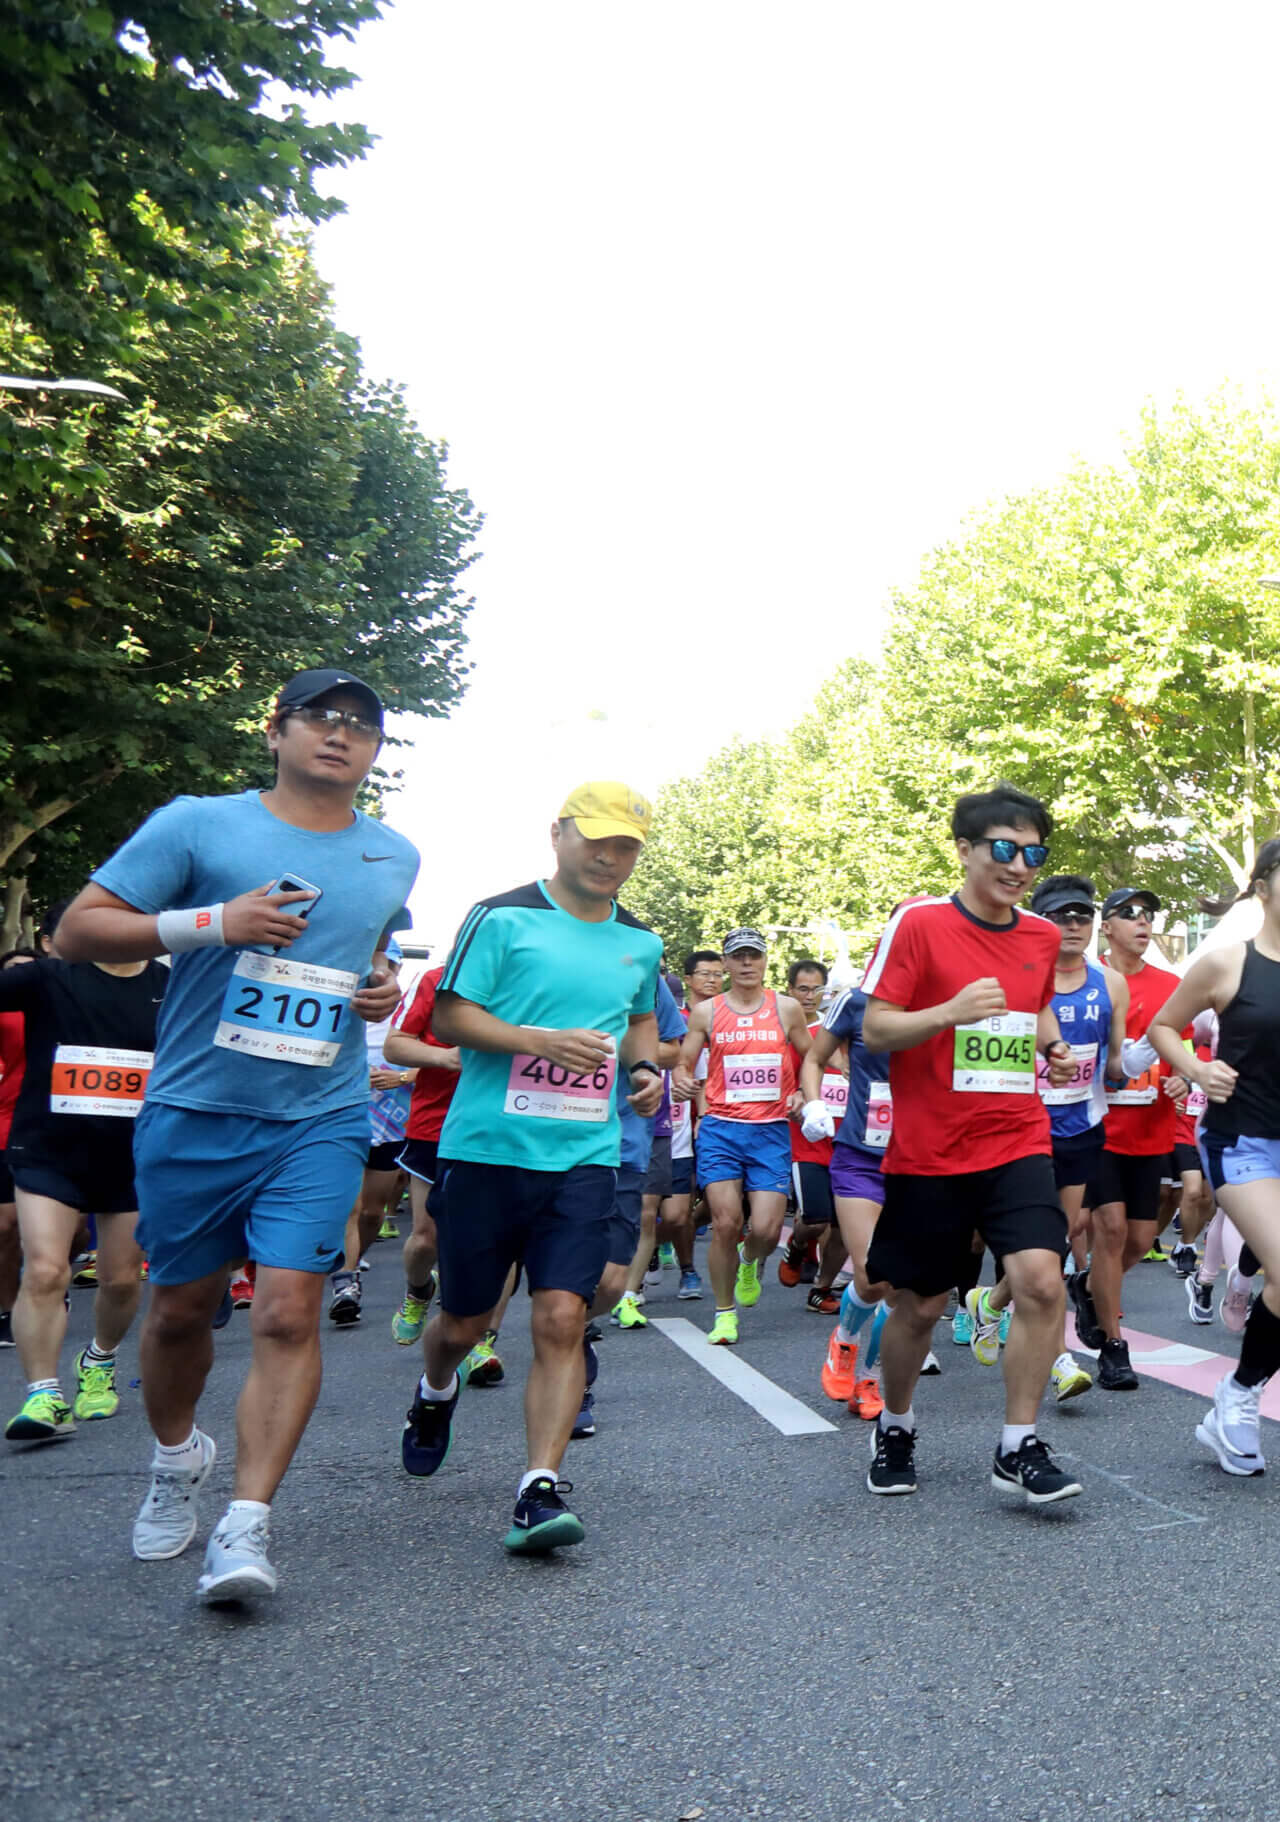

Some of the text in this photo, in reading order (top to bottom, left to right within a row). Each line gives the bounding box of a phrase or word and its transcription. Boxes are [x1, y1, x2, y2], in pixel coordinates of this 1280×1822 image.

[233, 986, 343, 1033] 2101
[991, 1017, 1001, 1032] B
[965, 1036, 1031, 1064] 8045
[64, 1068, 142, 1093] 1089
[729, 1068, 777, 1085] 4086
[514, 1095, 529, 1110] C
